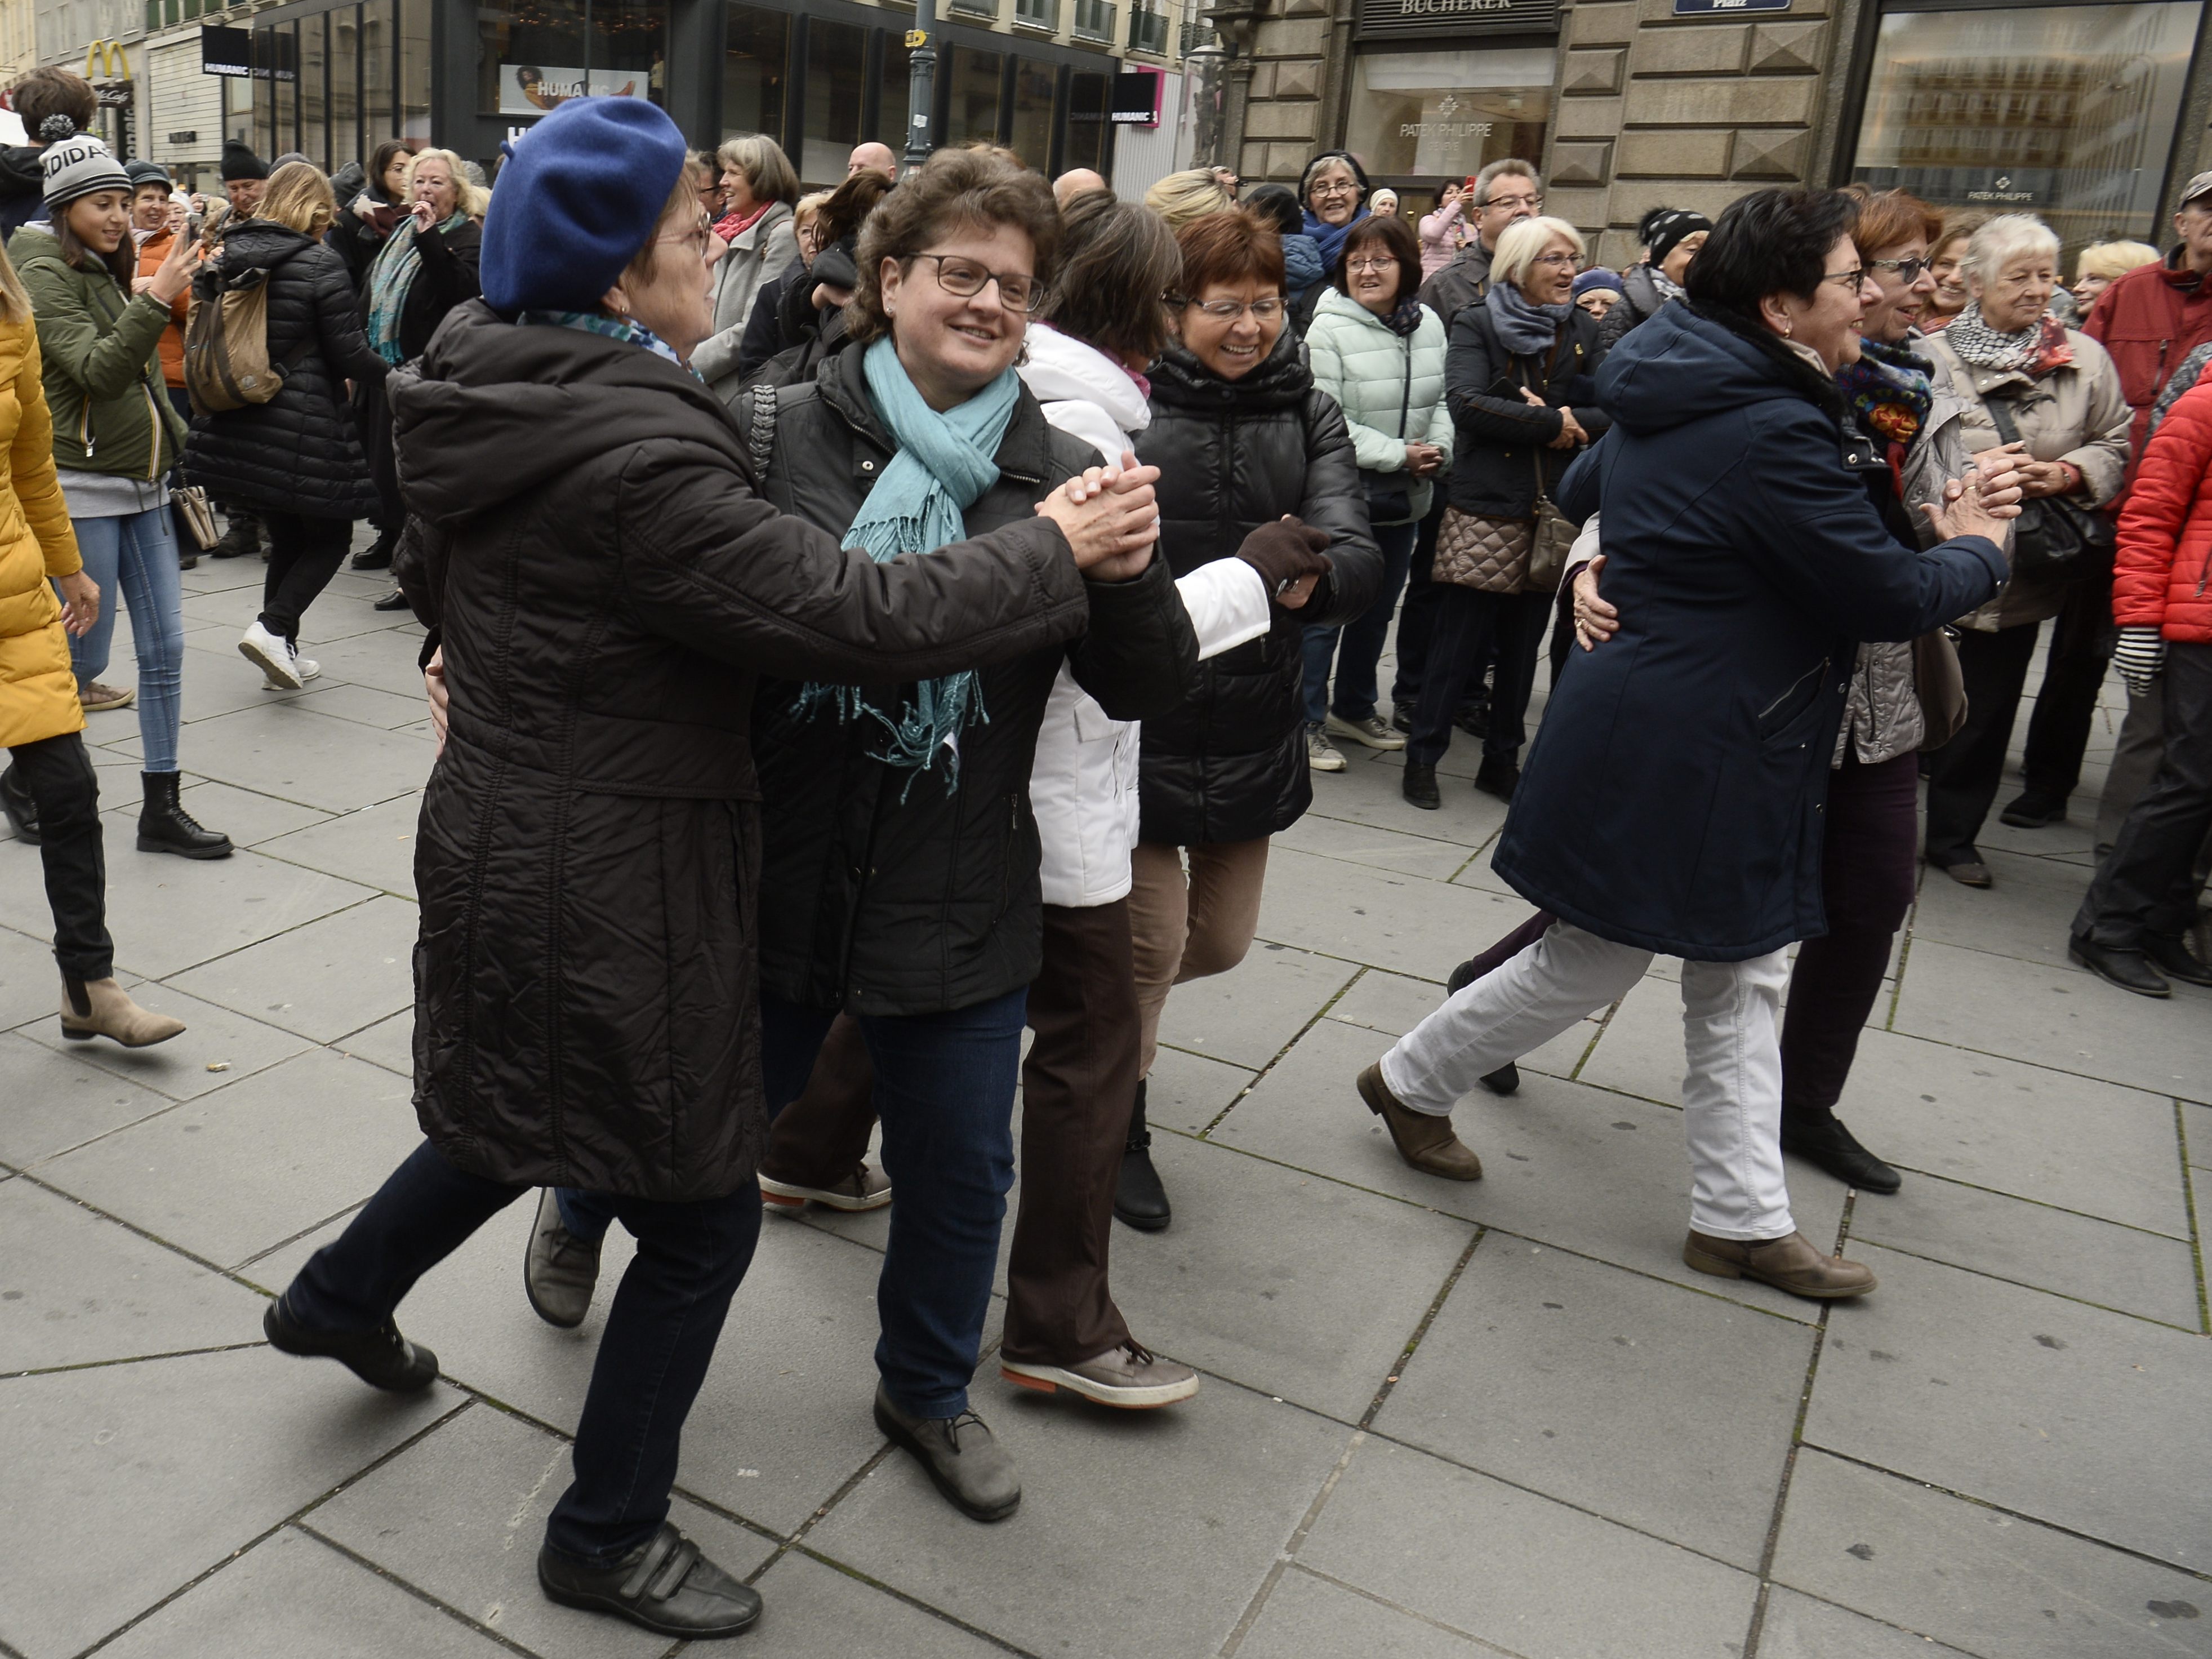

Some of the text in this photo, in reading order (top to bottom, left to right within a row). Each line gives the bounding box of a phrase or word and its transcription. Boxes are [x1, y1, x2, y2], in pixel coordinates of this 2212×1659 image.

[205, 63, 248, 75] HUMANIC
[1111, 112, 1150, 122] HUMANIC
[1400, 123, 1493, 137] PATEK PHILIPPE
[44, 145, 109, 179] ADIDA
[1968, 191, 2034, 201] PATEK PHILIPPE
